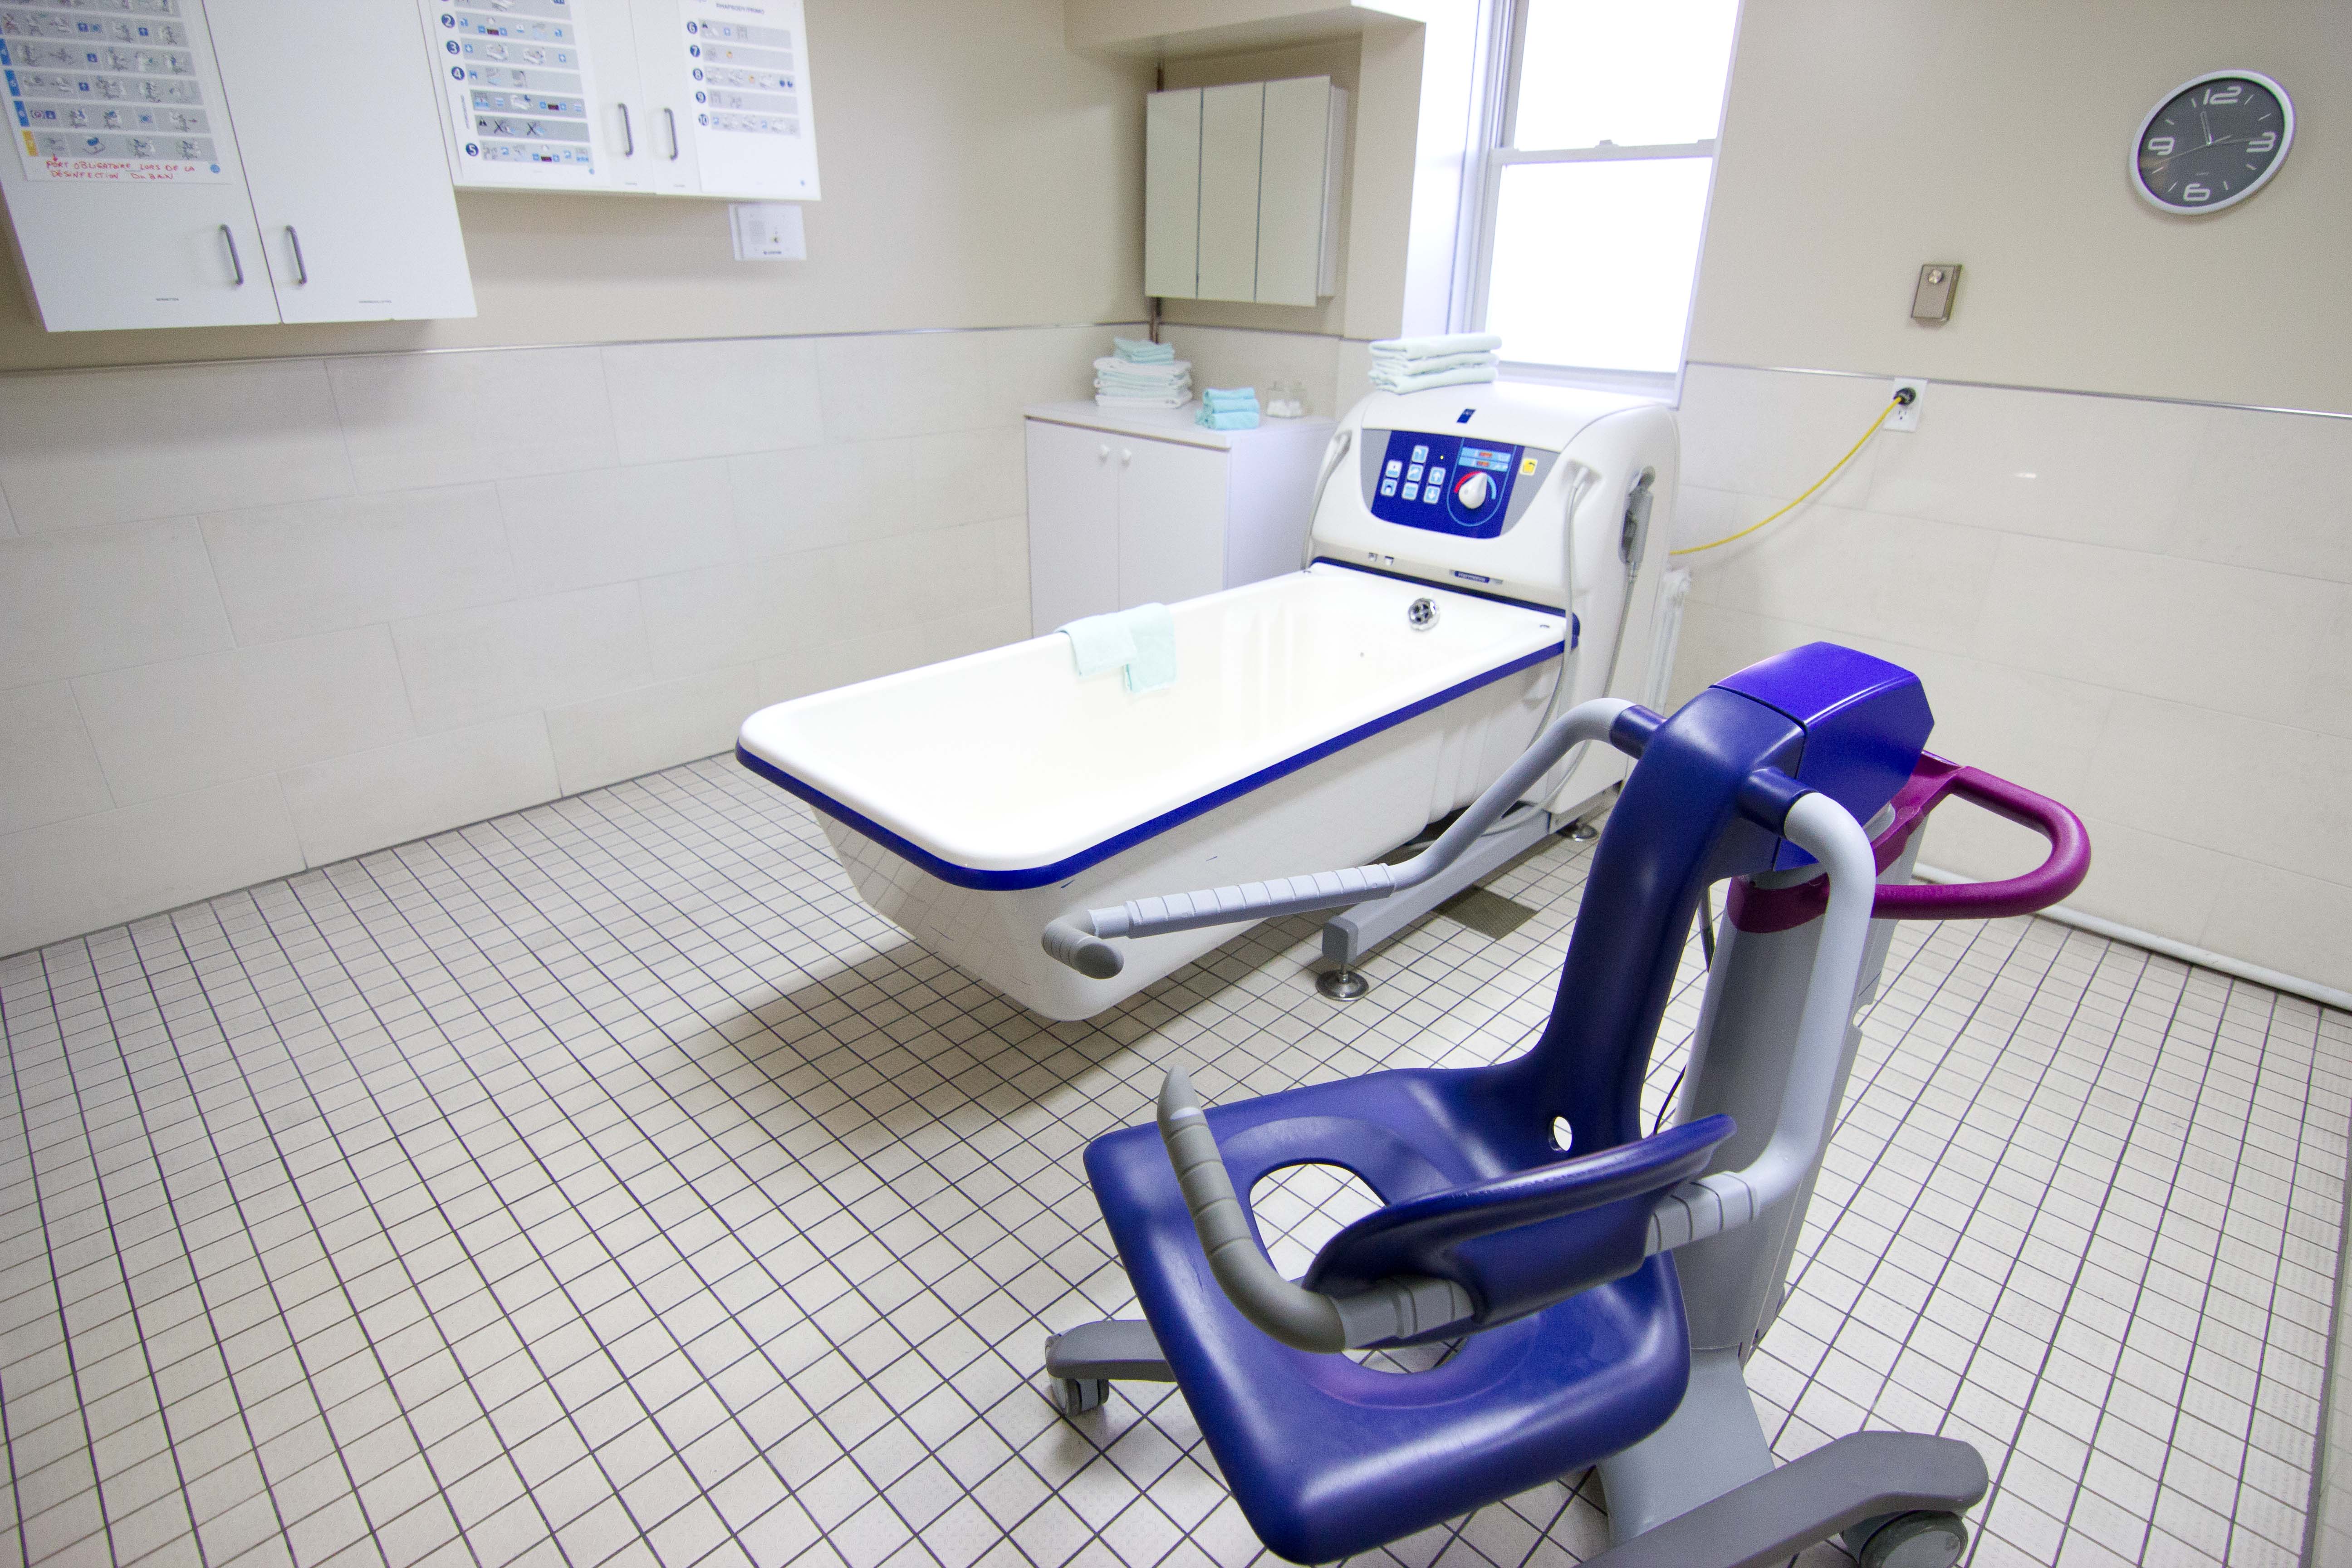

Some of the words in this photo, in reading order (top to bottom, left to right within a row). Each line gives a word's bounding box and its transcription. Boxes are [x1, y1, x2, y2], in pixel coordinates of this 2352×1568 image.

[444, 15, 453, 27] 2
[449, 42, 458, 53] 3
[454, 69, 462, 79] 4
[2203, 86, 2242, 105] 12
[2148, 137, 2175, 156] 9
[2246, 131, 2277, 152] 3
[468, 144, 476, 155] 5
[2183, 182, 2211, 201] 6
